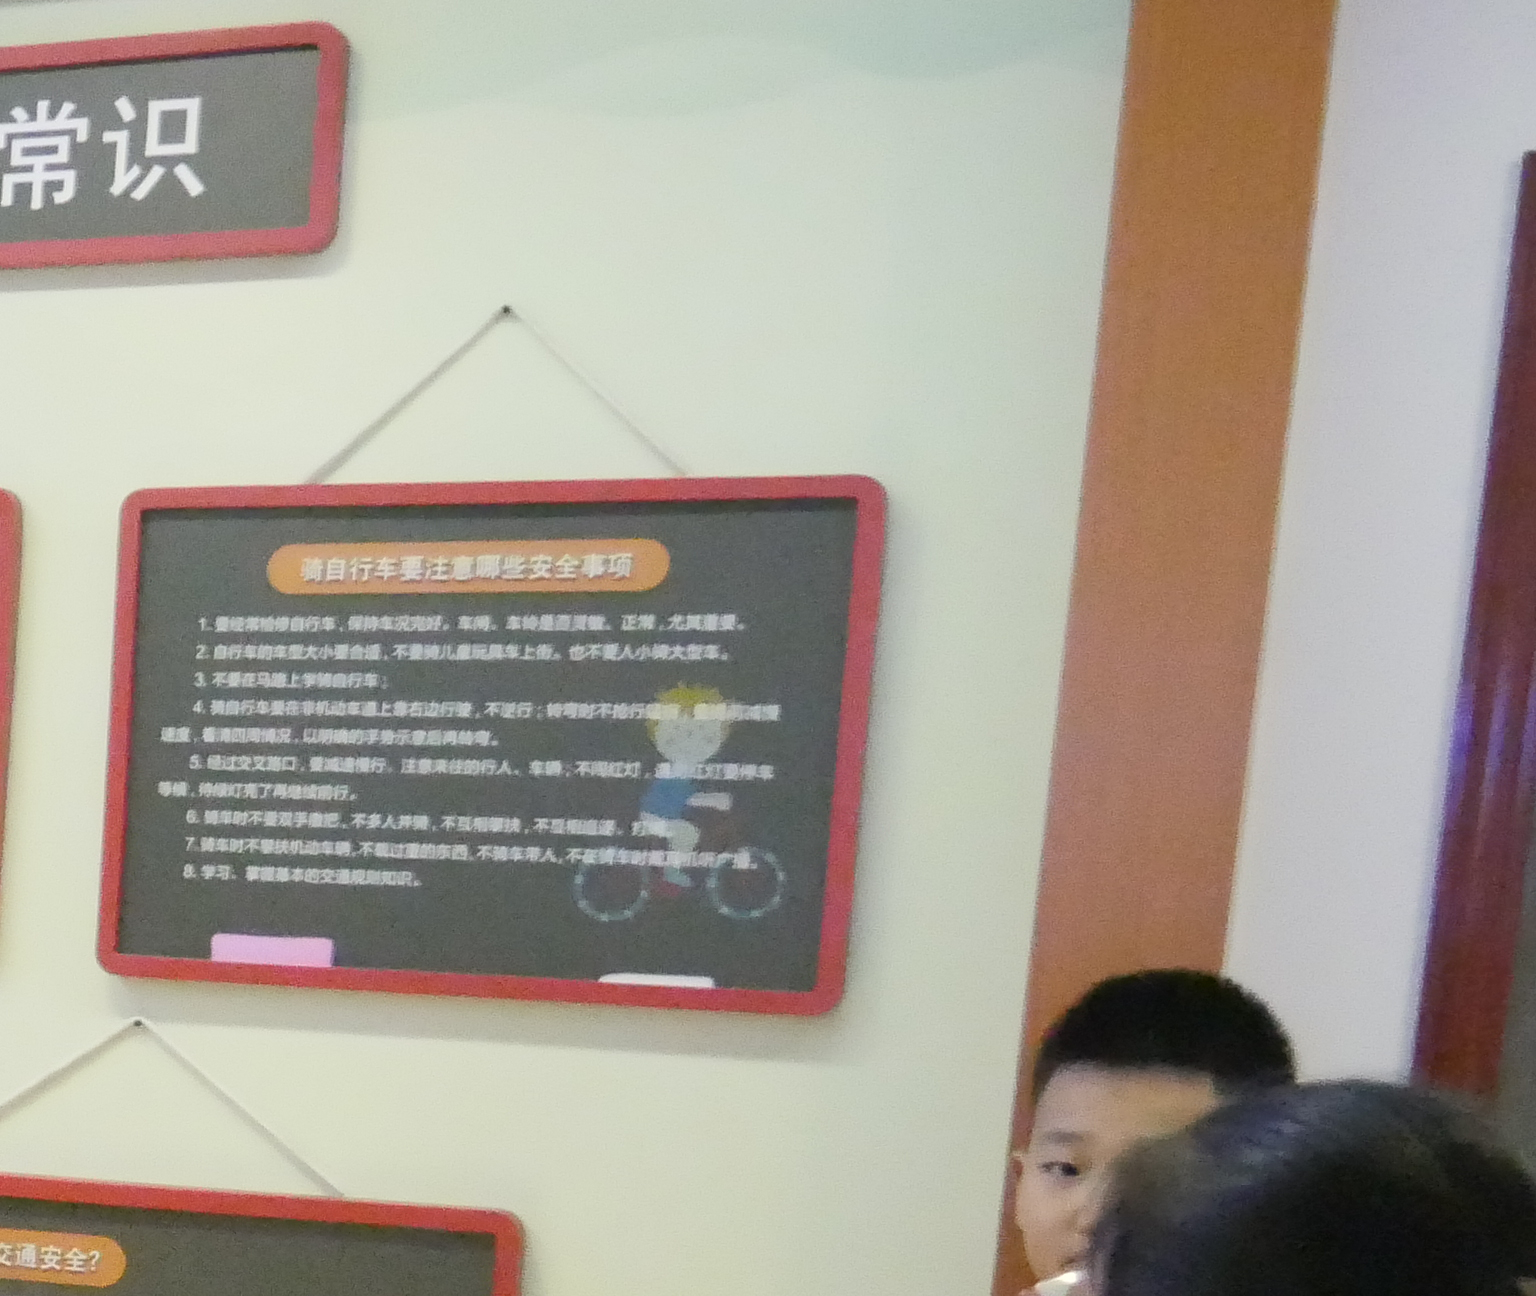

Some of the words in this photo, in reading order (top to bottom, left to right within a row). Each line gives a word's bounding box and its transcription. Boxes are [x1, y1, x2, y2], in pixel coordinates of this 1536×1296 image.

[300, 553, 634, 582] 骑自行车要注意哪些安全事项
